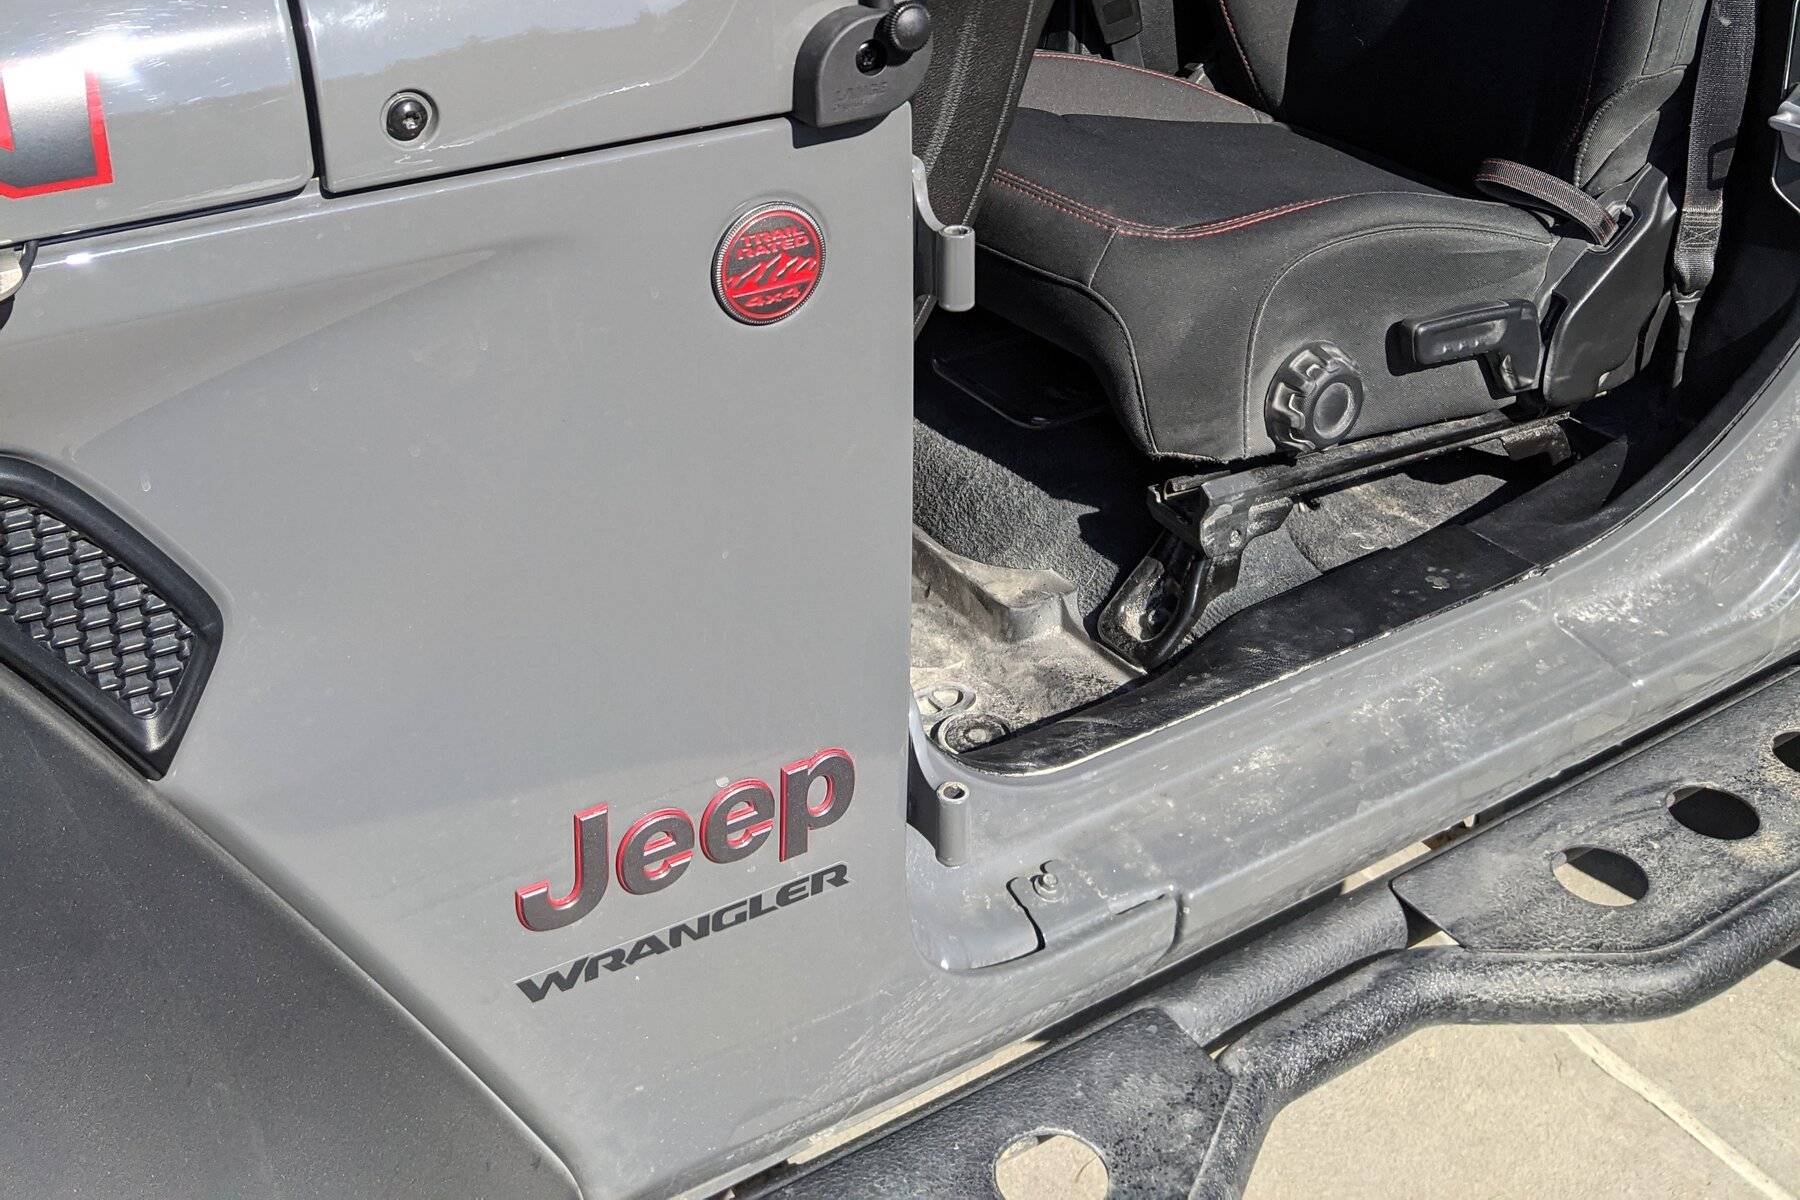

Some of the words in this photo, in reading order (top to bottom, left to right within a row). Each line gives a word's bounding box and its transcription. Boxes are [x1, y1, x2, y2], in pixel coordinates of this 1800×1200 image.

[735, 233, 810, 260] RATED
[515, 746, 856, 932] Jeep
[514, 862, 850, 1003] WRANGLER
